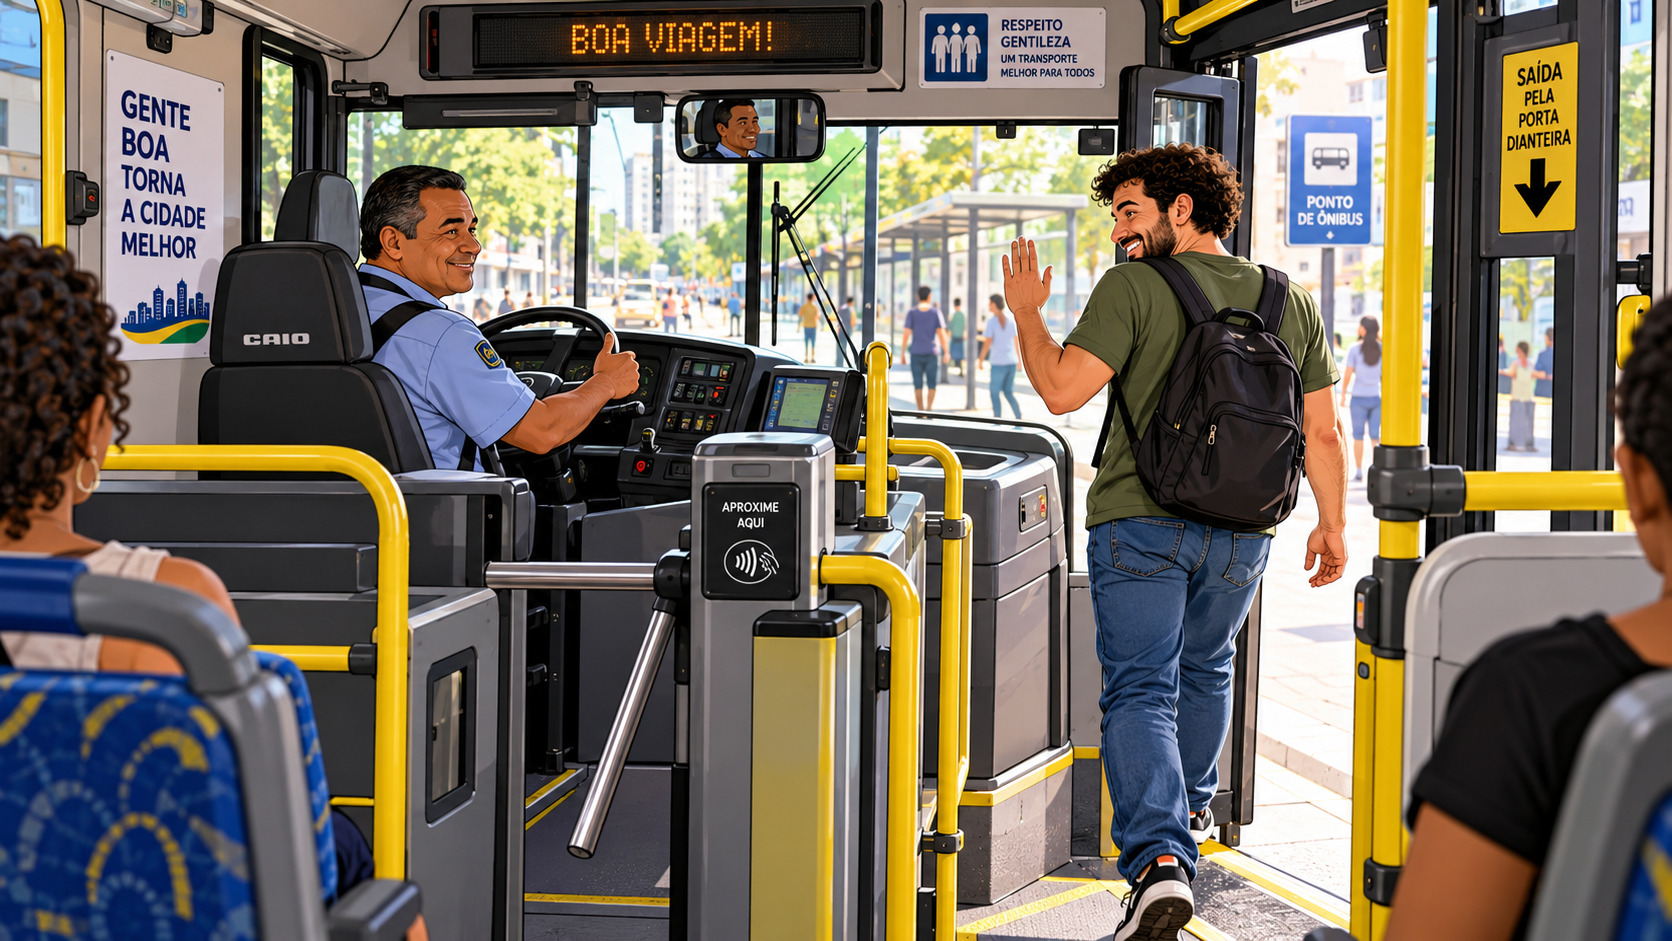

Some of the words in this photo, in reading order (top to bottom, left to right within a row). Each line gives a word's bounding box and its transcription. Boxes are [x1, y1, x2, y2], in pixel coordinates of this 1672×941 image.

[1002, 19, 1062, 31] RESPEITO
[572, 24, 629, 54] BOA
[646, 22, 771, 52] VIAGEM!
[1001, 36, 1071, 48] GENTILEZA
[1001, 54, 1015, 63] UM
[1018, 54, 1077, 63] TRANSPORTE
[1001, 68, 1037, 77] MELHOR
[1040, 68, 1062, 77] PARA
[1065, 68, 1094, 77] TODOS
[1517, 60, 1562, 86] SAÍDA
[1525, 88, 1554, 106] PELA
[121, 90, 190, 131] GENTE
[1519, 109, 1559, 128] PORTA
[122, 127, 170, 162] BOA
[1507, 129, 1571, 151] DIANTEIRA
[121, 164, 186, 196] TORNA
[1307, 196, 1353, 209] PONTO
[121, 199, 135, 223] A
[141, 201, 205, 229] CIDADE
[1298, 213, 1314, 225] DE
[1317, 209, 1363, 225] ÔNIBUS
[122, 232, 196, 259] MELHOR
[244, 333, 309, 345] CAIO
[722, 502, 778, 512] APROXIME
[737, 517, 764, 529] AQUI
